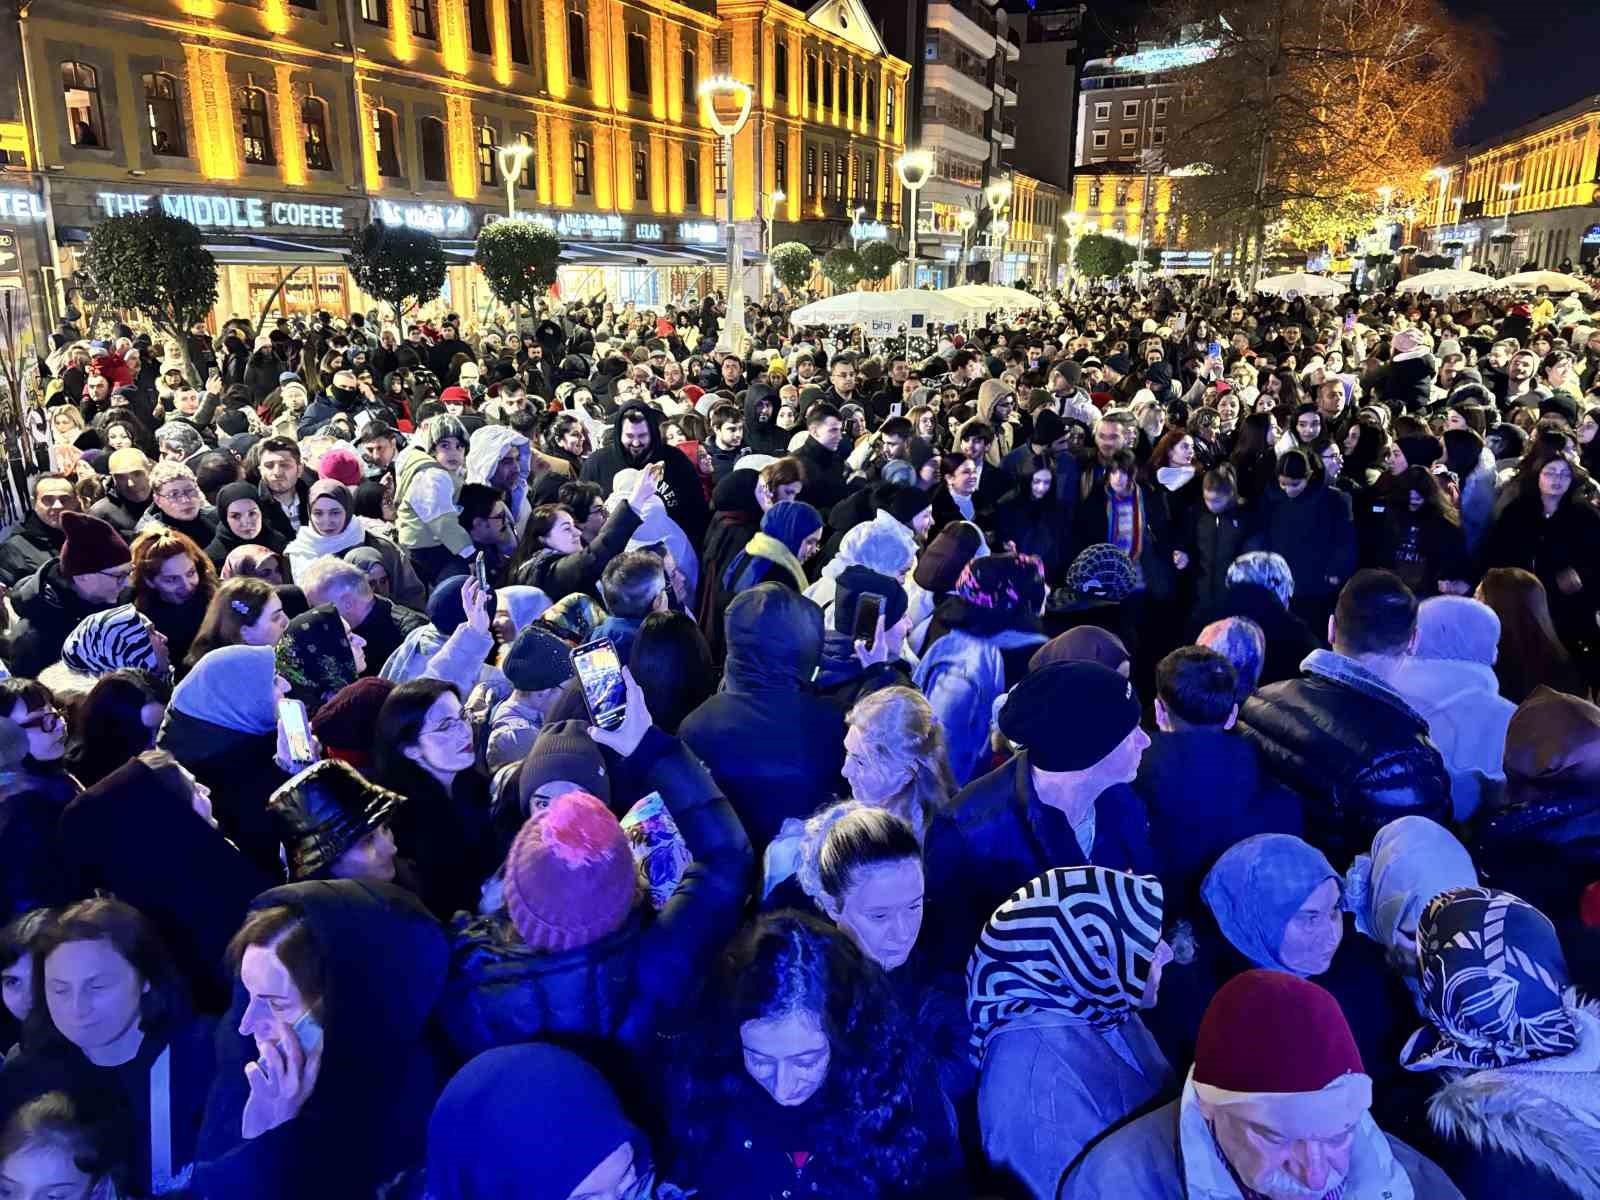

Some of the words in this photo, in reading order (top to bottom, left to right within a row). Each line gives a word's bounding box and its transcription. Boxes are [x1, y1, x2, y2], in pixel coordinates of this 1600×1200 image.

[97, 193, 151, 217] THE
[162, 194, 265, 227] MIDDLE
[272, 202, 345, 229] COFFEE
